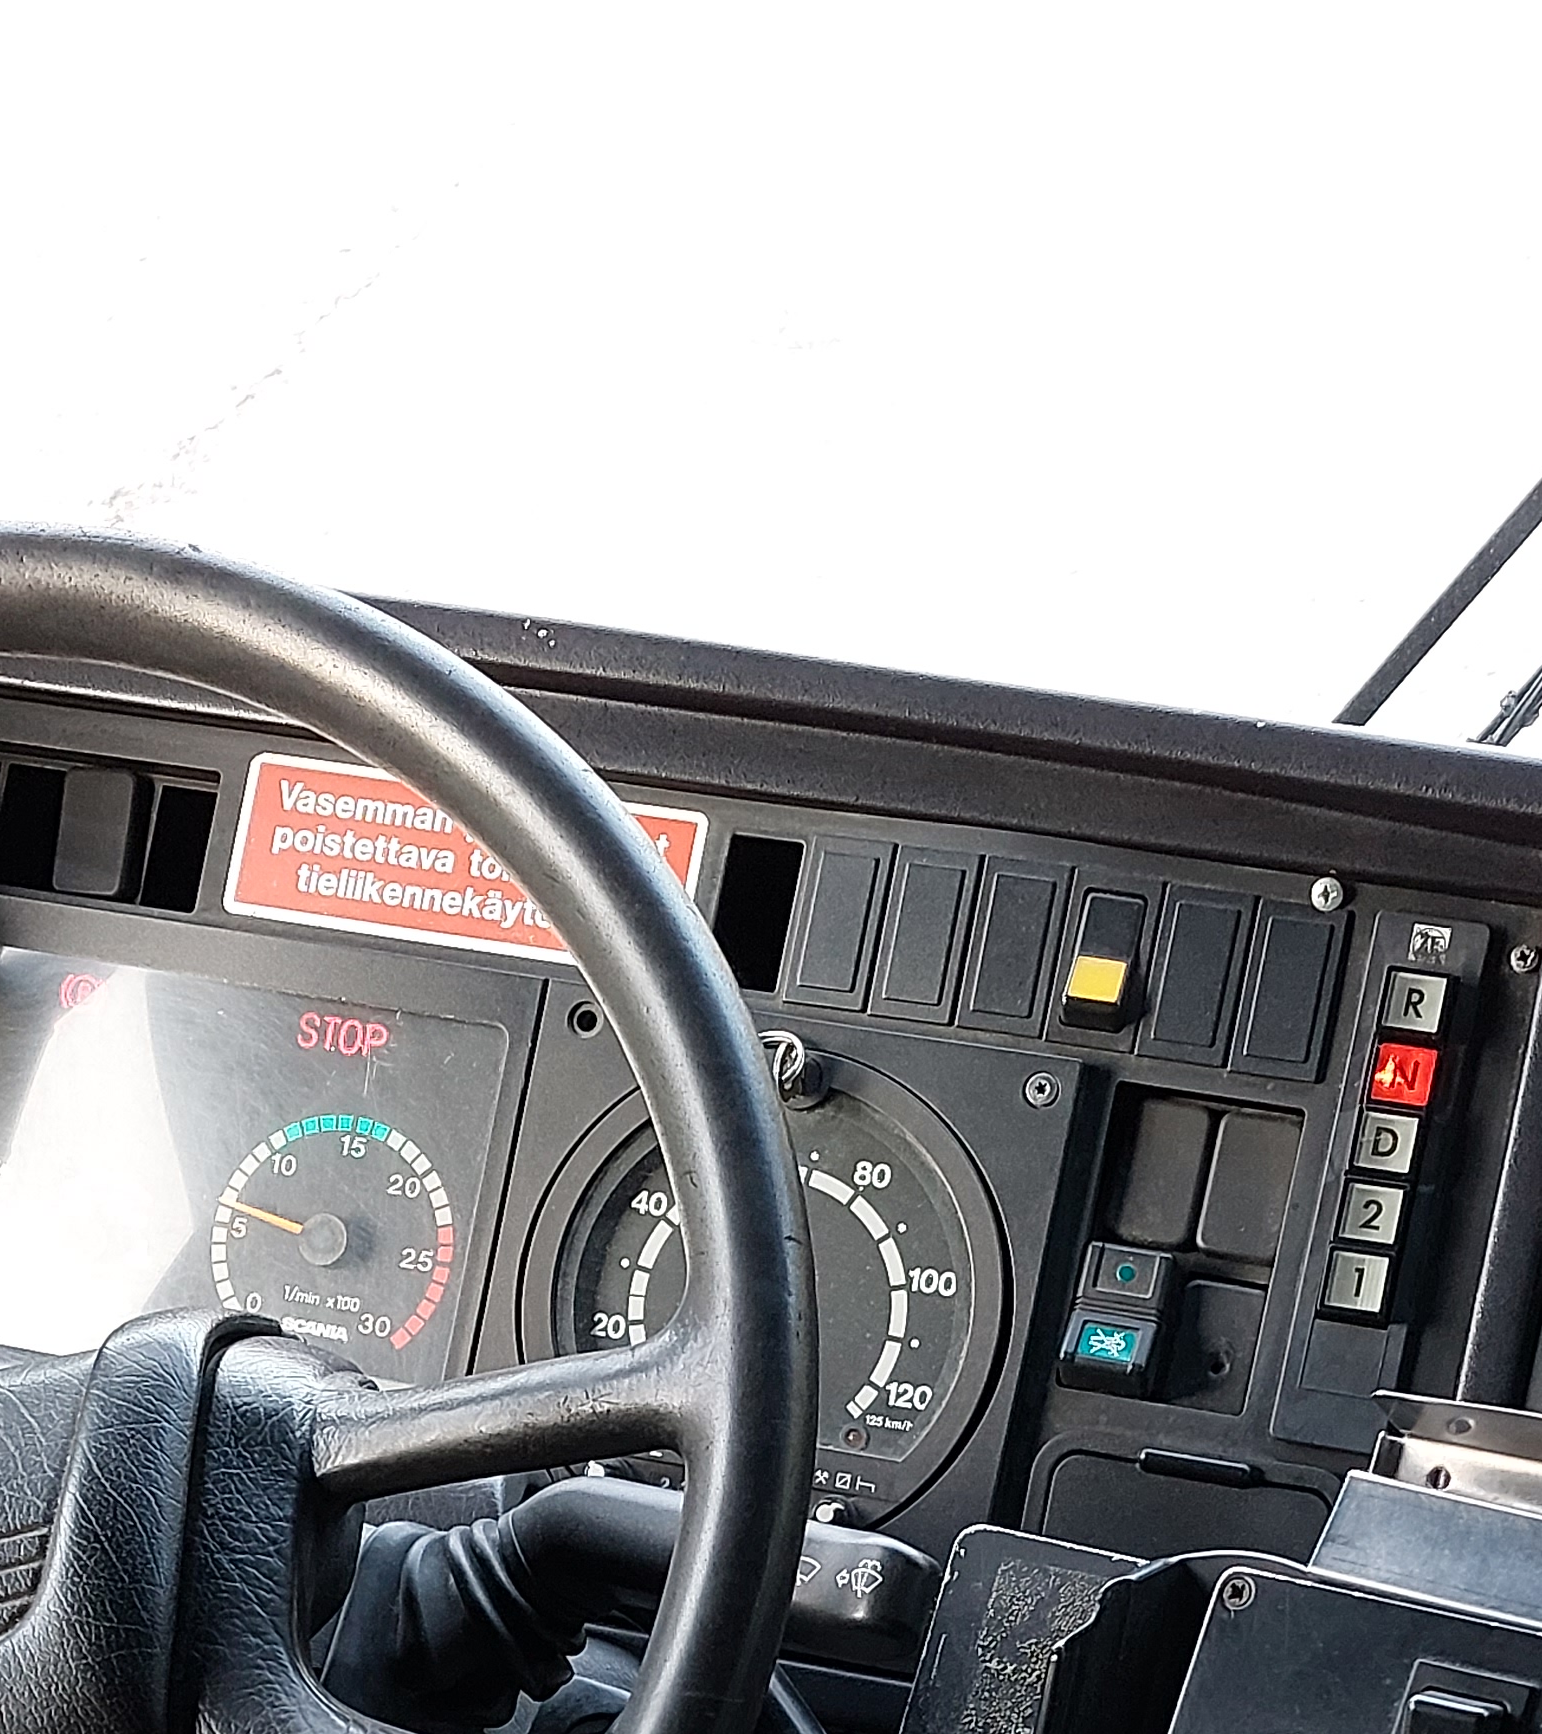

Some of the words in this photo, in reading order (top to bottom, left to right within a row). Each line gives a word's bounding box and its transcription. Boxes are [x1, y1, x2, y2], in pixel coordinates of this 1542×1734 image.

[279, 779, 454, 834] Vasemman
[272, 825, 455, 874] poistettava
[1402, 987, 1425, 1019] R
[297, 1011, 390, 1057] STOP
[1386, 1058, 1420, 1091] N
[340, 1134, 368, 1158] 15
[1370, 1126, 1399, 1157] D
[271, 1152, 297, 1176] 10
[853, 1160, 892, 1189] 80
[386, 1174, 421, 1198] 20
[631, 1190, 668, 1217] 40
[1358, 1199, 1384, 1231] 2
[230, 1218, 247, 1238] 5
[398, 1248, 434, 1272] 25
[908, 1267, 957, 1297] 100
[1353, 1266, 1366, 1298] 1
[246, 1292, 262, 1313] 0
[283, 1284, 320, 1305] 1/min
[326, 1295, 360, 1313] x100
[280, 1316, 349, 1343] SCANIA
[358, 1313, 391, 1337] 30
[590, 1312, 626, 1340] 20
[884, 1382, 933, 1410] 120
[865, 1414, 884, 1428] 125
[885, 1416, 914, 1432] km/h
